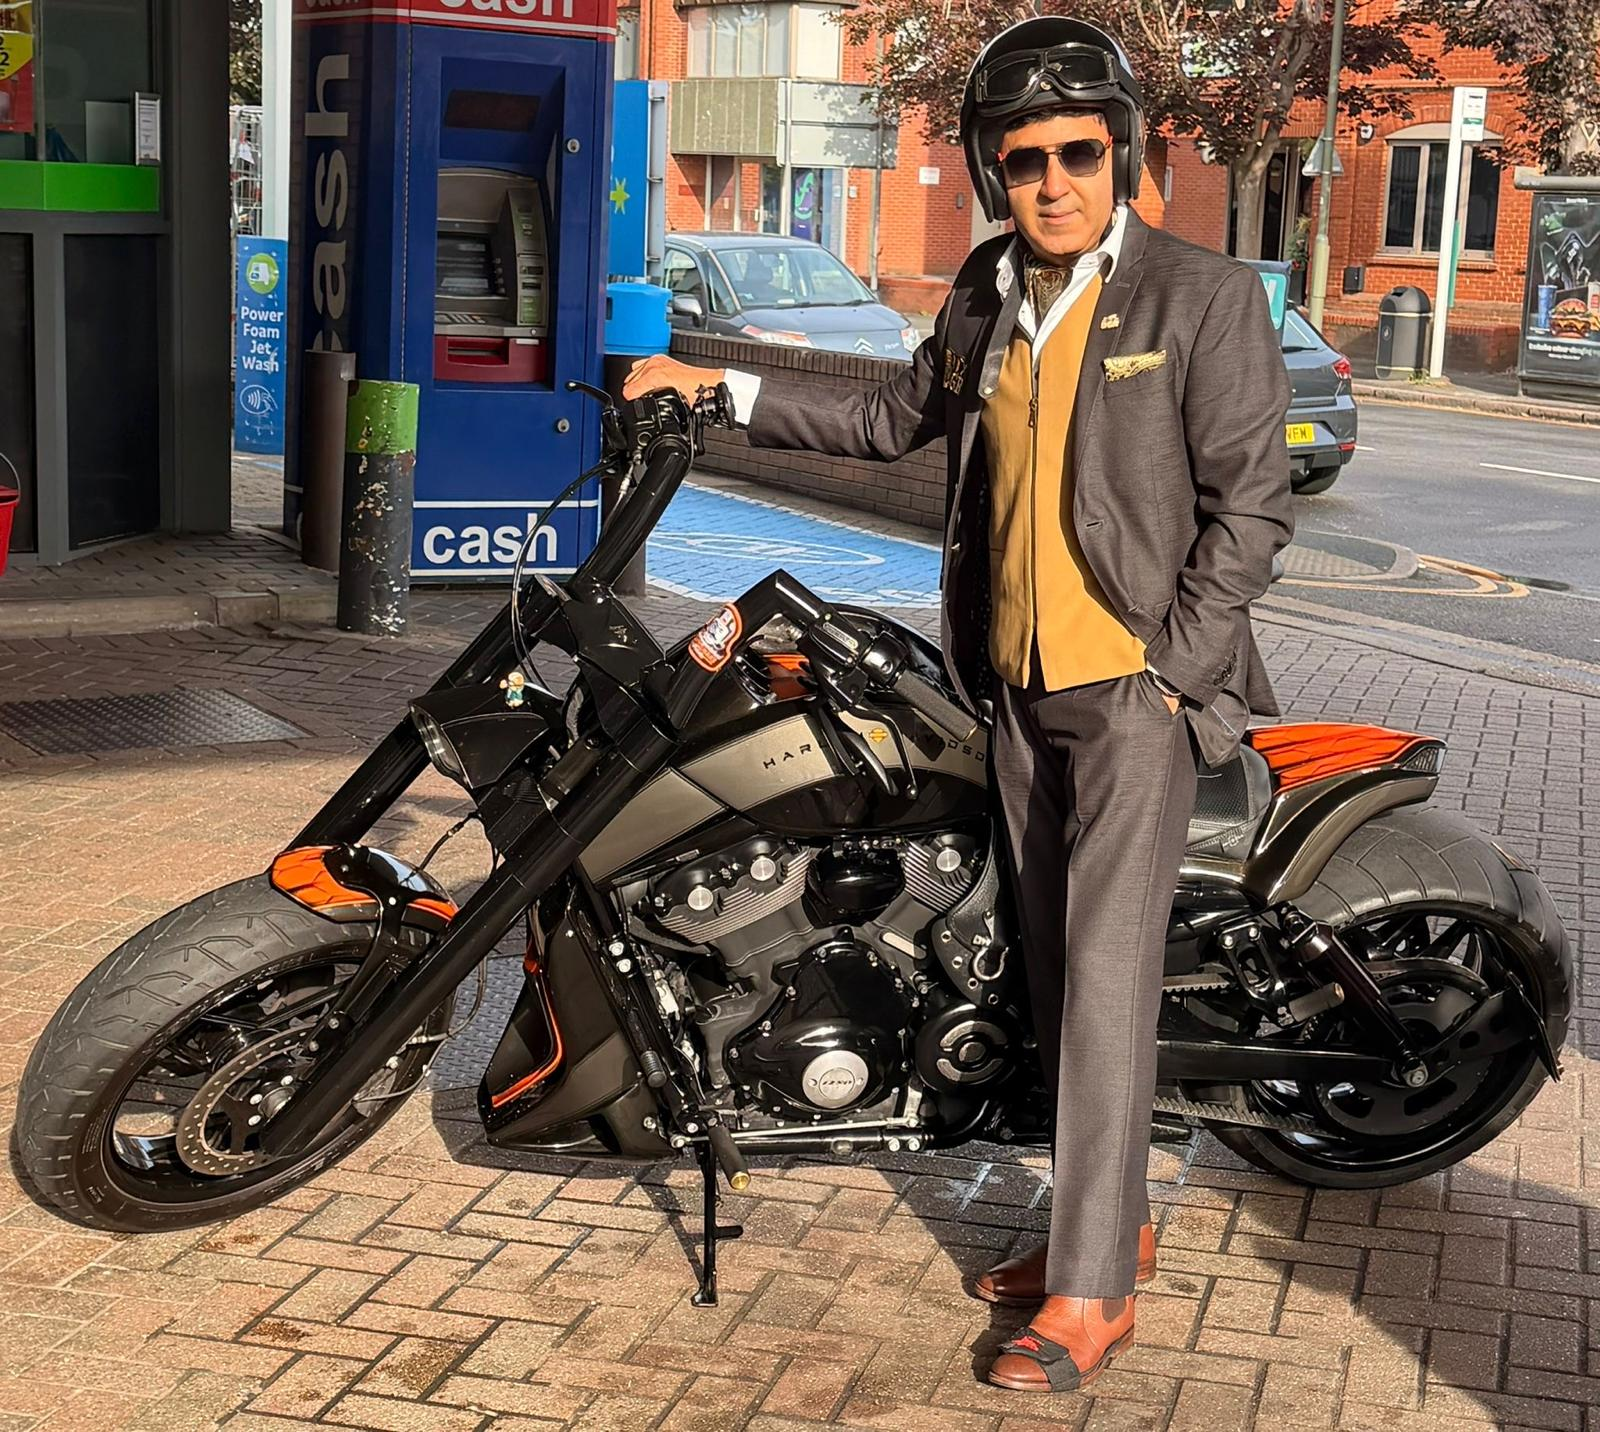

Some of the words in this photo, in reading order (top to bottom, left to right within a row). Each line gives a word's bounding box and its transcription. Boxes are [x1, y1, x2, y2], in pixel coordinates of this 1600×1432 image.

[304, 54, 349, 351] ash
[241, 305, 284, 322] Power
[243, 322, 280, 339] Foam
[250, 340, 271, 355] Jet
[242, 355, 279, 373] Wash
[422, 512, 558, 565] cash
[763, 743, 812, 769] HAR
